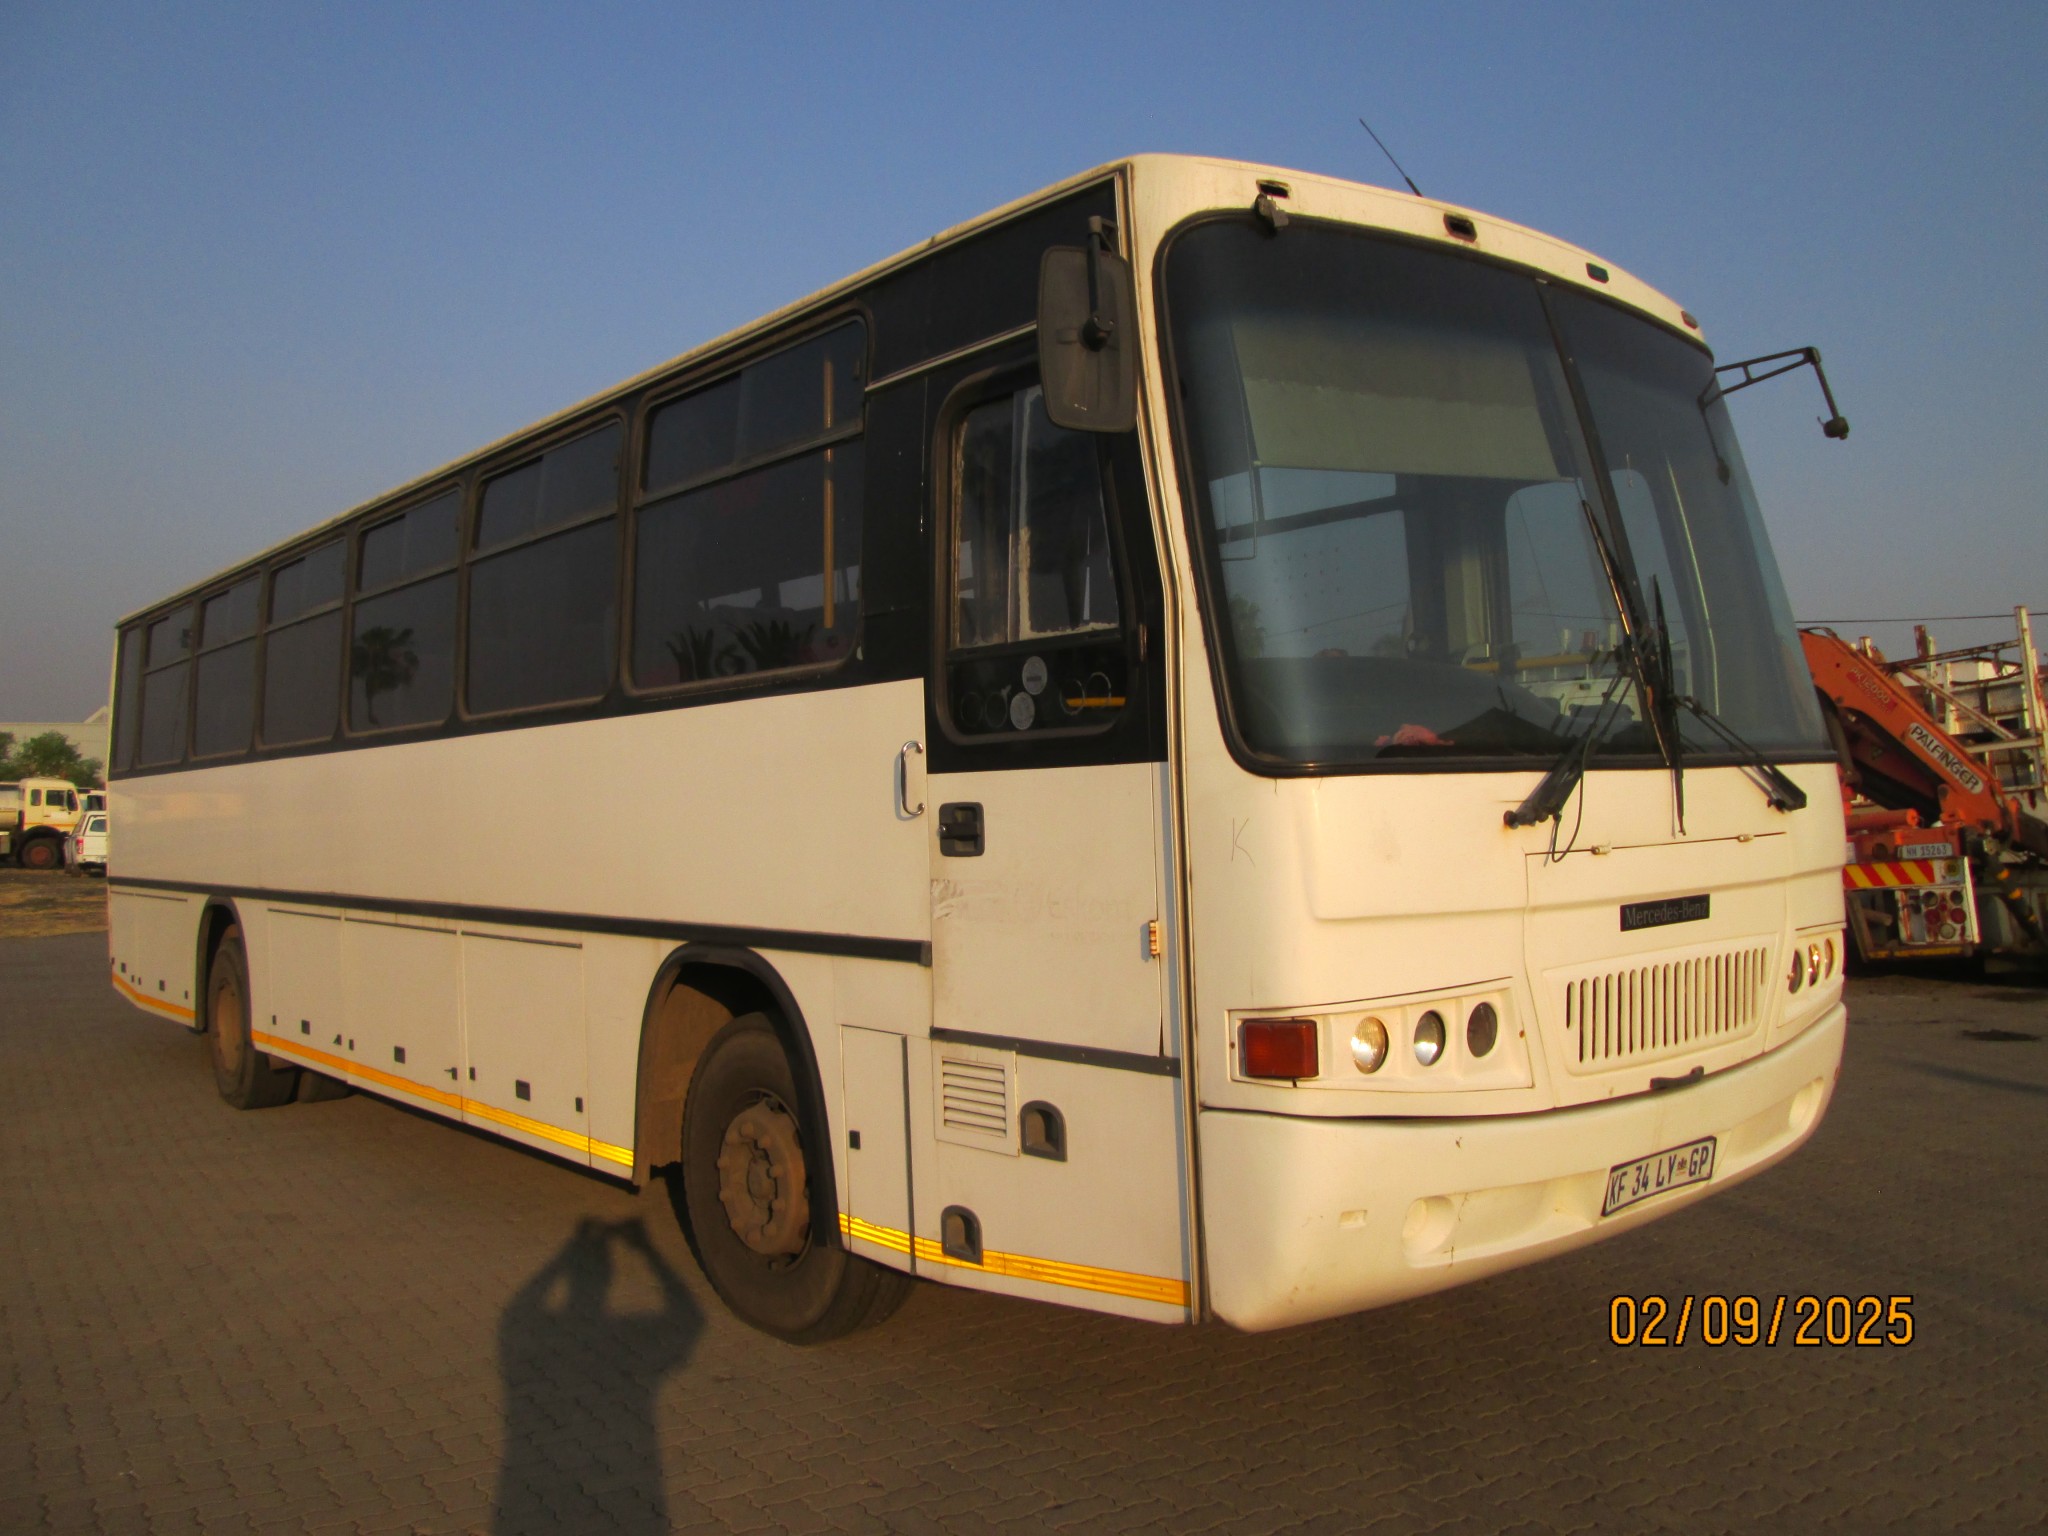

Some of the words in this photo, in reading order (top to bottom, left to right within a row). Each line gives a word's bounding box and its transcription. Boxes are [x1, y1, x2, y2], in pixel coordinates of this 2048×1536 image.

[1910, 726, 1980, 790] PALFINGER
[1625, 900, 1708, 928] Mercedes-Benz
[1609, 1171, 1628, 1208] KF
[1632, 1162, 1650, 1197] 34
[1655, 1154, 1677, 1188] LY
[1688, 1146, 1709, 1178] GP
